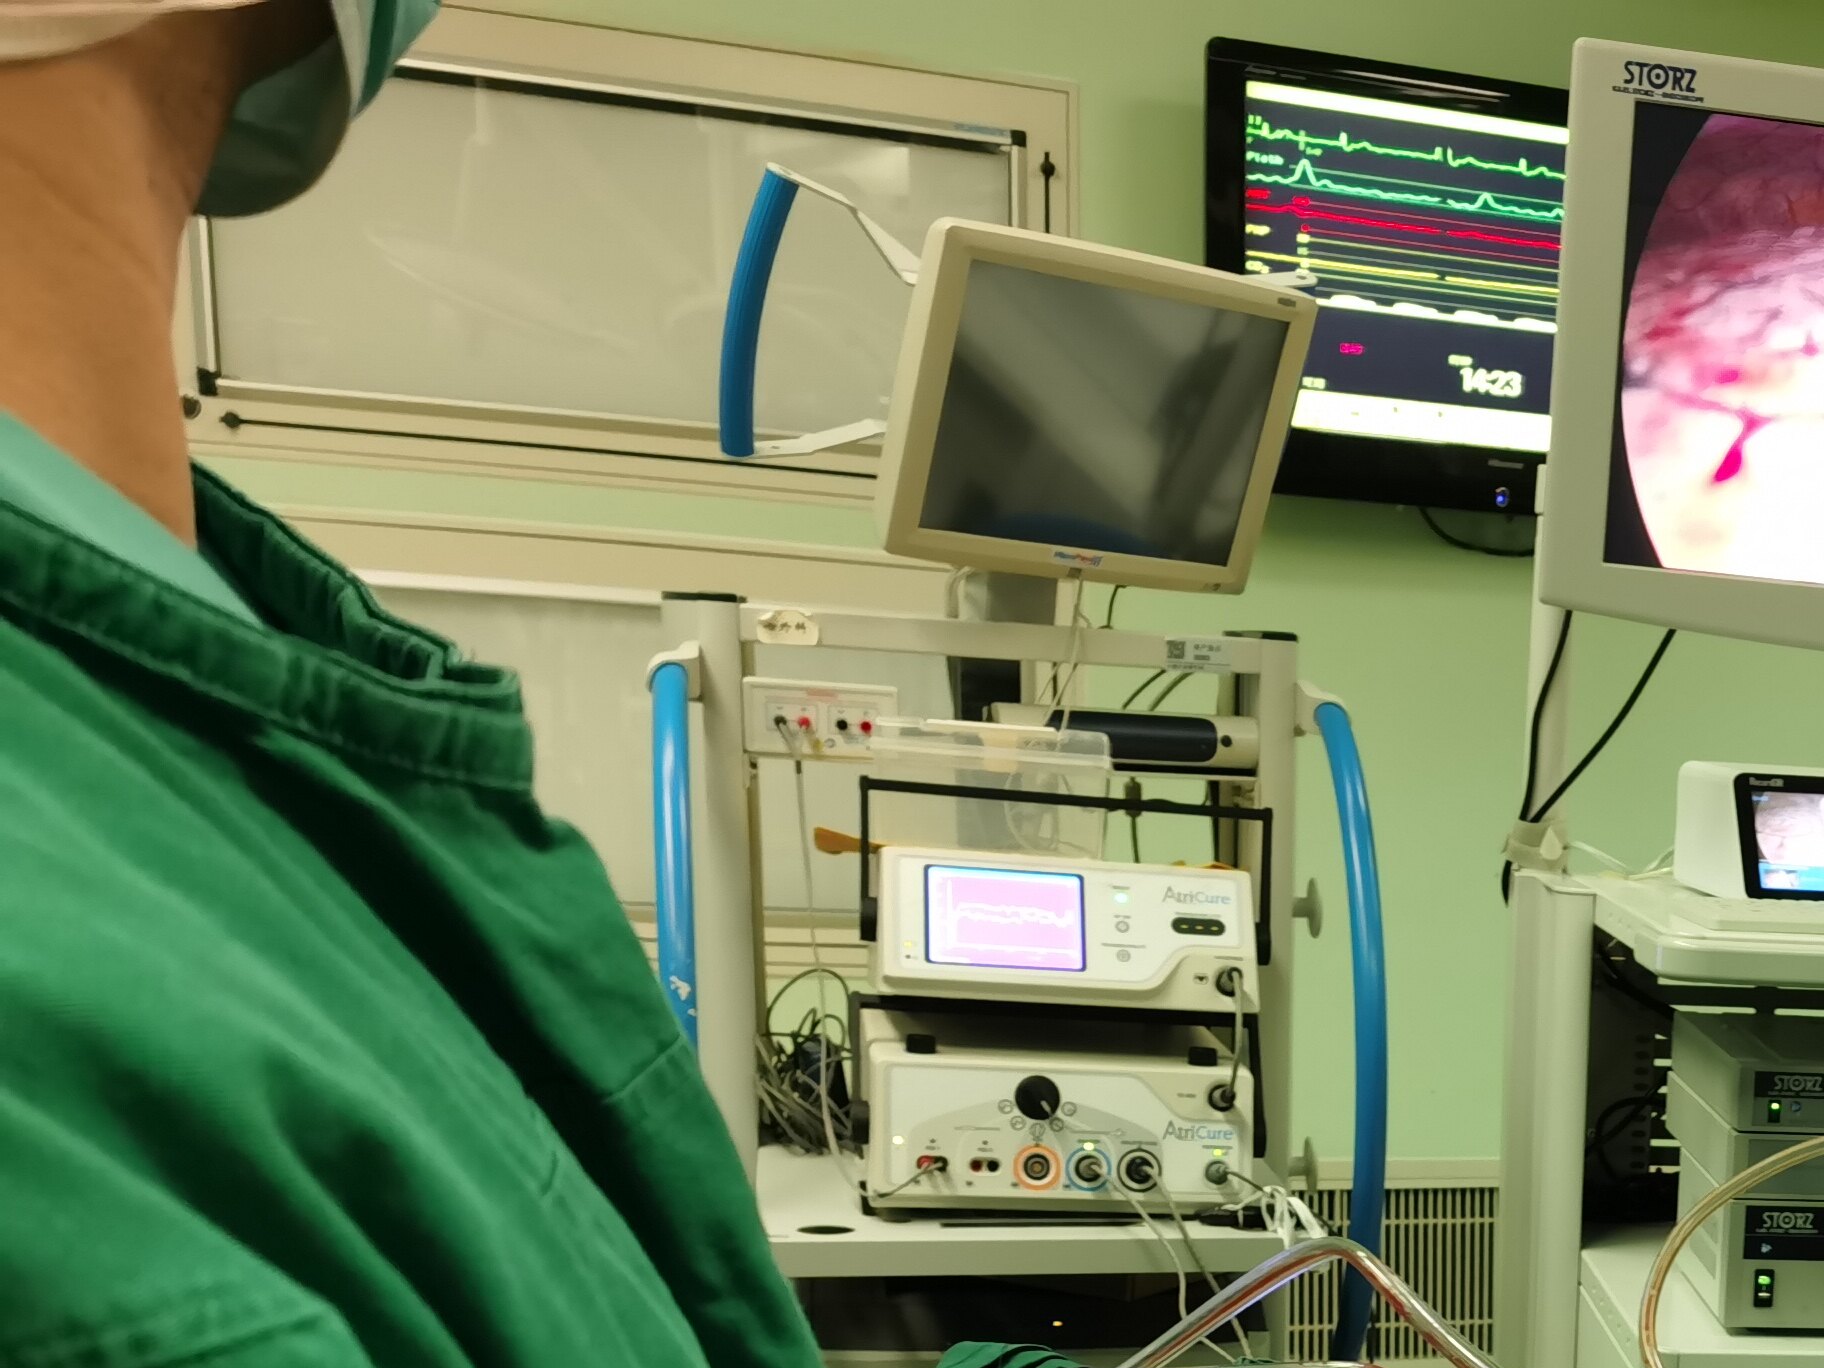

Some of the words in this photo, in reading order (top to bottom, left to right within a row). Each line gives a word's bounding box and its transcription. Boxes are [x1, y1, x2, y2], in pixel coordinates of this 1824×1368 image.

[1623, 61, 1697, 93] STORZ
[1162, 885, 1232, 905] AtriCure
[1774, 1075, 1823, 1092] STORZ
[1162, 1120, 1234, 1141] AtriCure
[1762, 1211, 1815, 1229] STORZ
